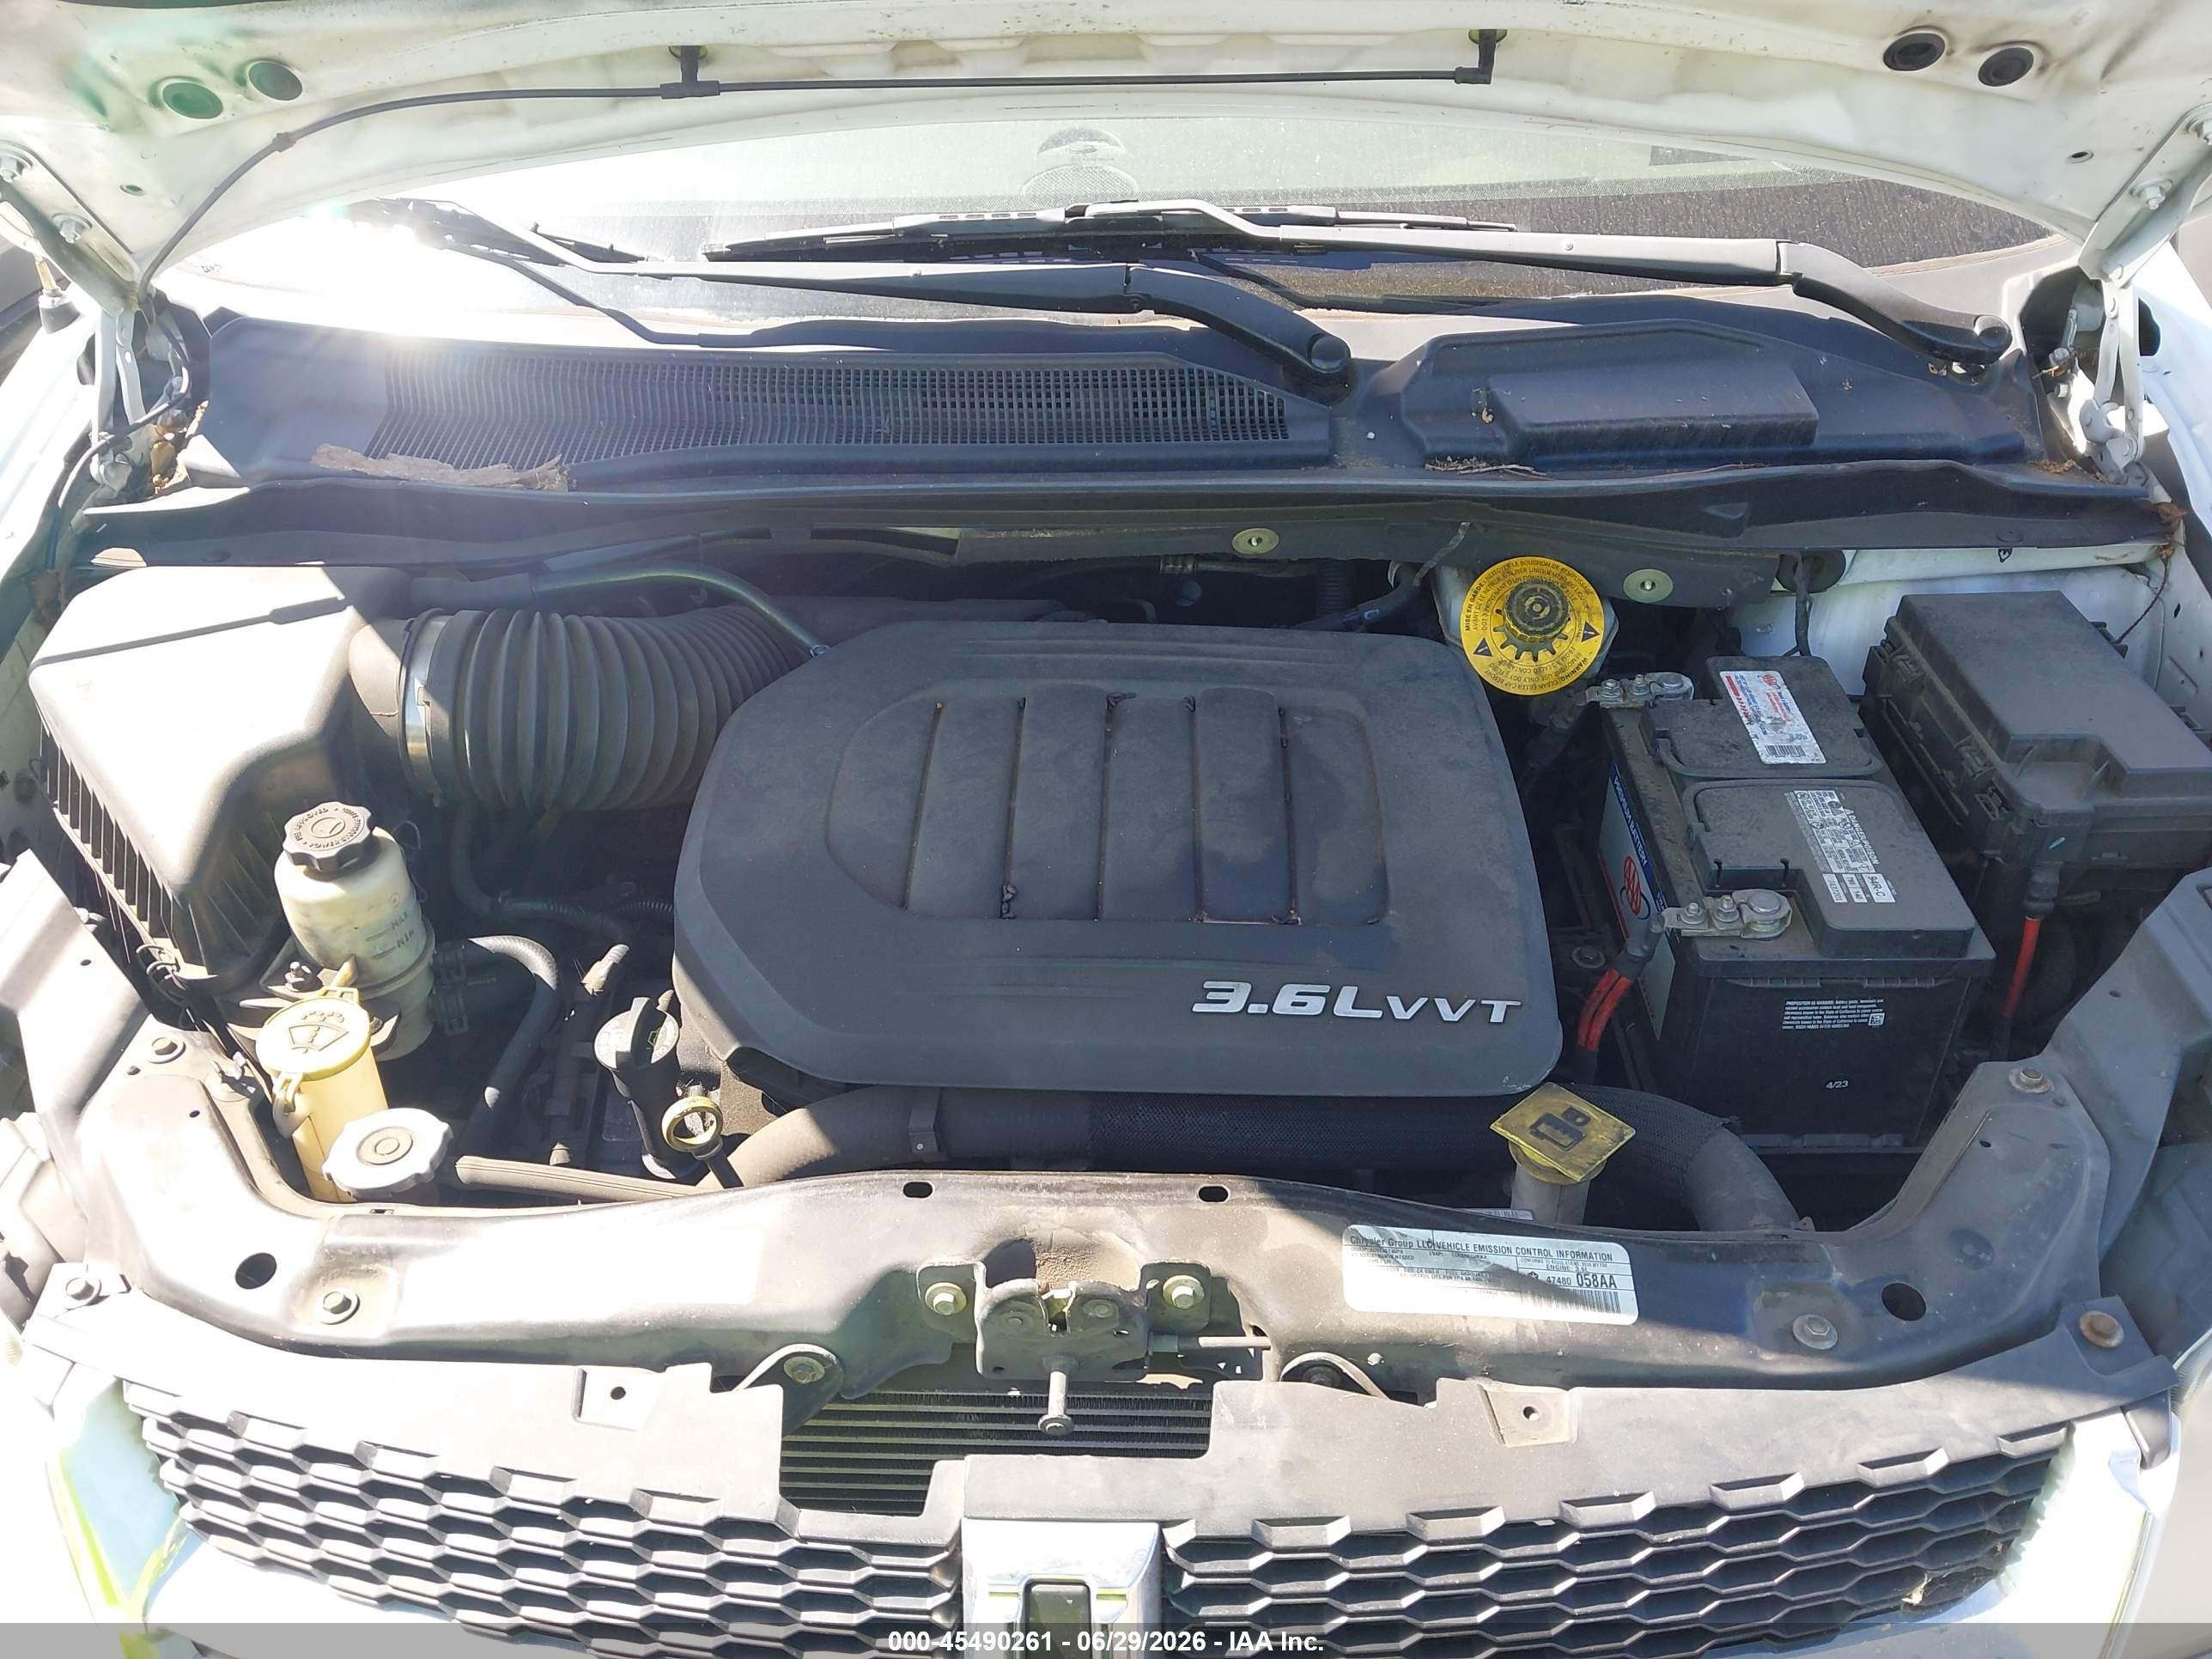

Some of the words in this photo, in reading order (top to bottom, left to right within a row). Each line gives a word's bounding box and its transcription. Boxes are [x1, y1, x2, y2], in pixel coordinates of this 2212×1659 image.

[1614, 775, 1632, 823] PREMIUM
[1629, 820, 1648, 866] BATTERY
[1826, 1079, 1849, 1089] 4/23
[1388, 1237, 1414, 1249] Group
[1435, 1241, 1470, 1252] VEHICLE
[1473, 1243, 1512, 1255] EMISSION
[1516, 1246, 1553, 1258] CONTROL
[1556, 1249, 1613, 1261] INFORMATION
[1577, 1273, 1618, 1289] 058AA
